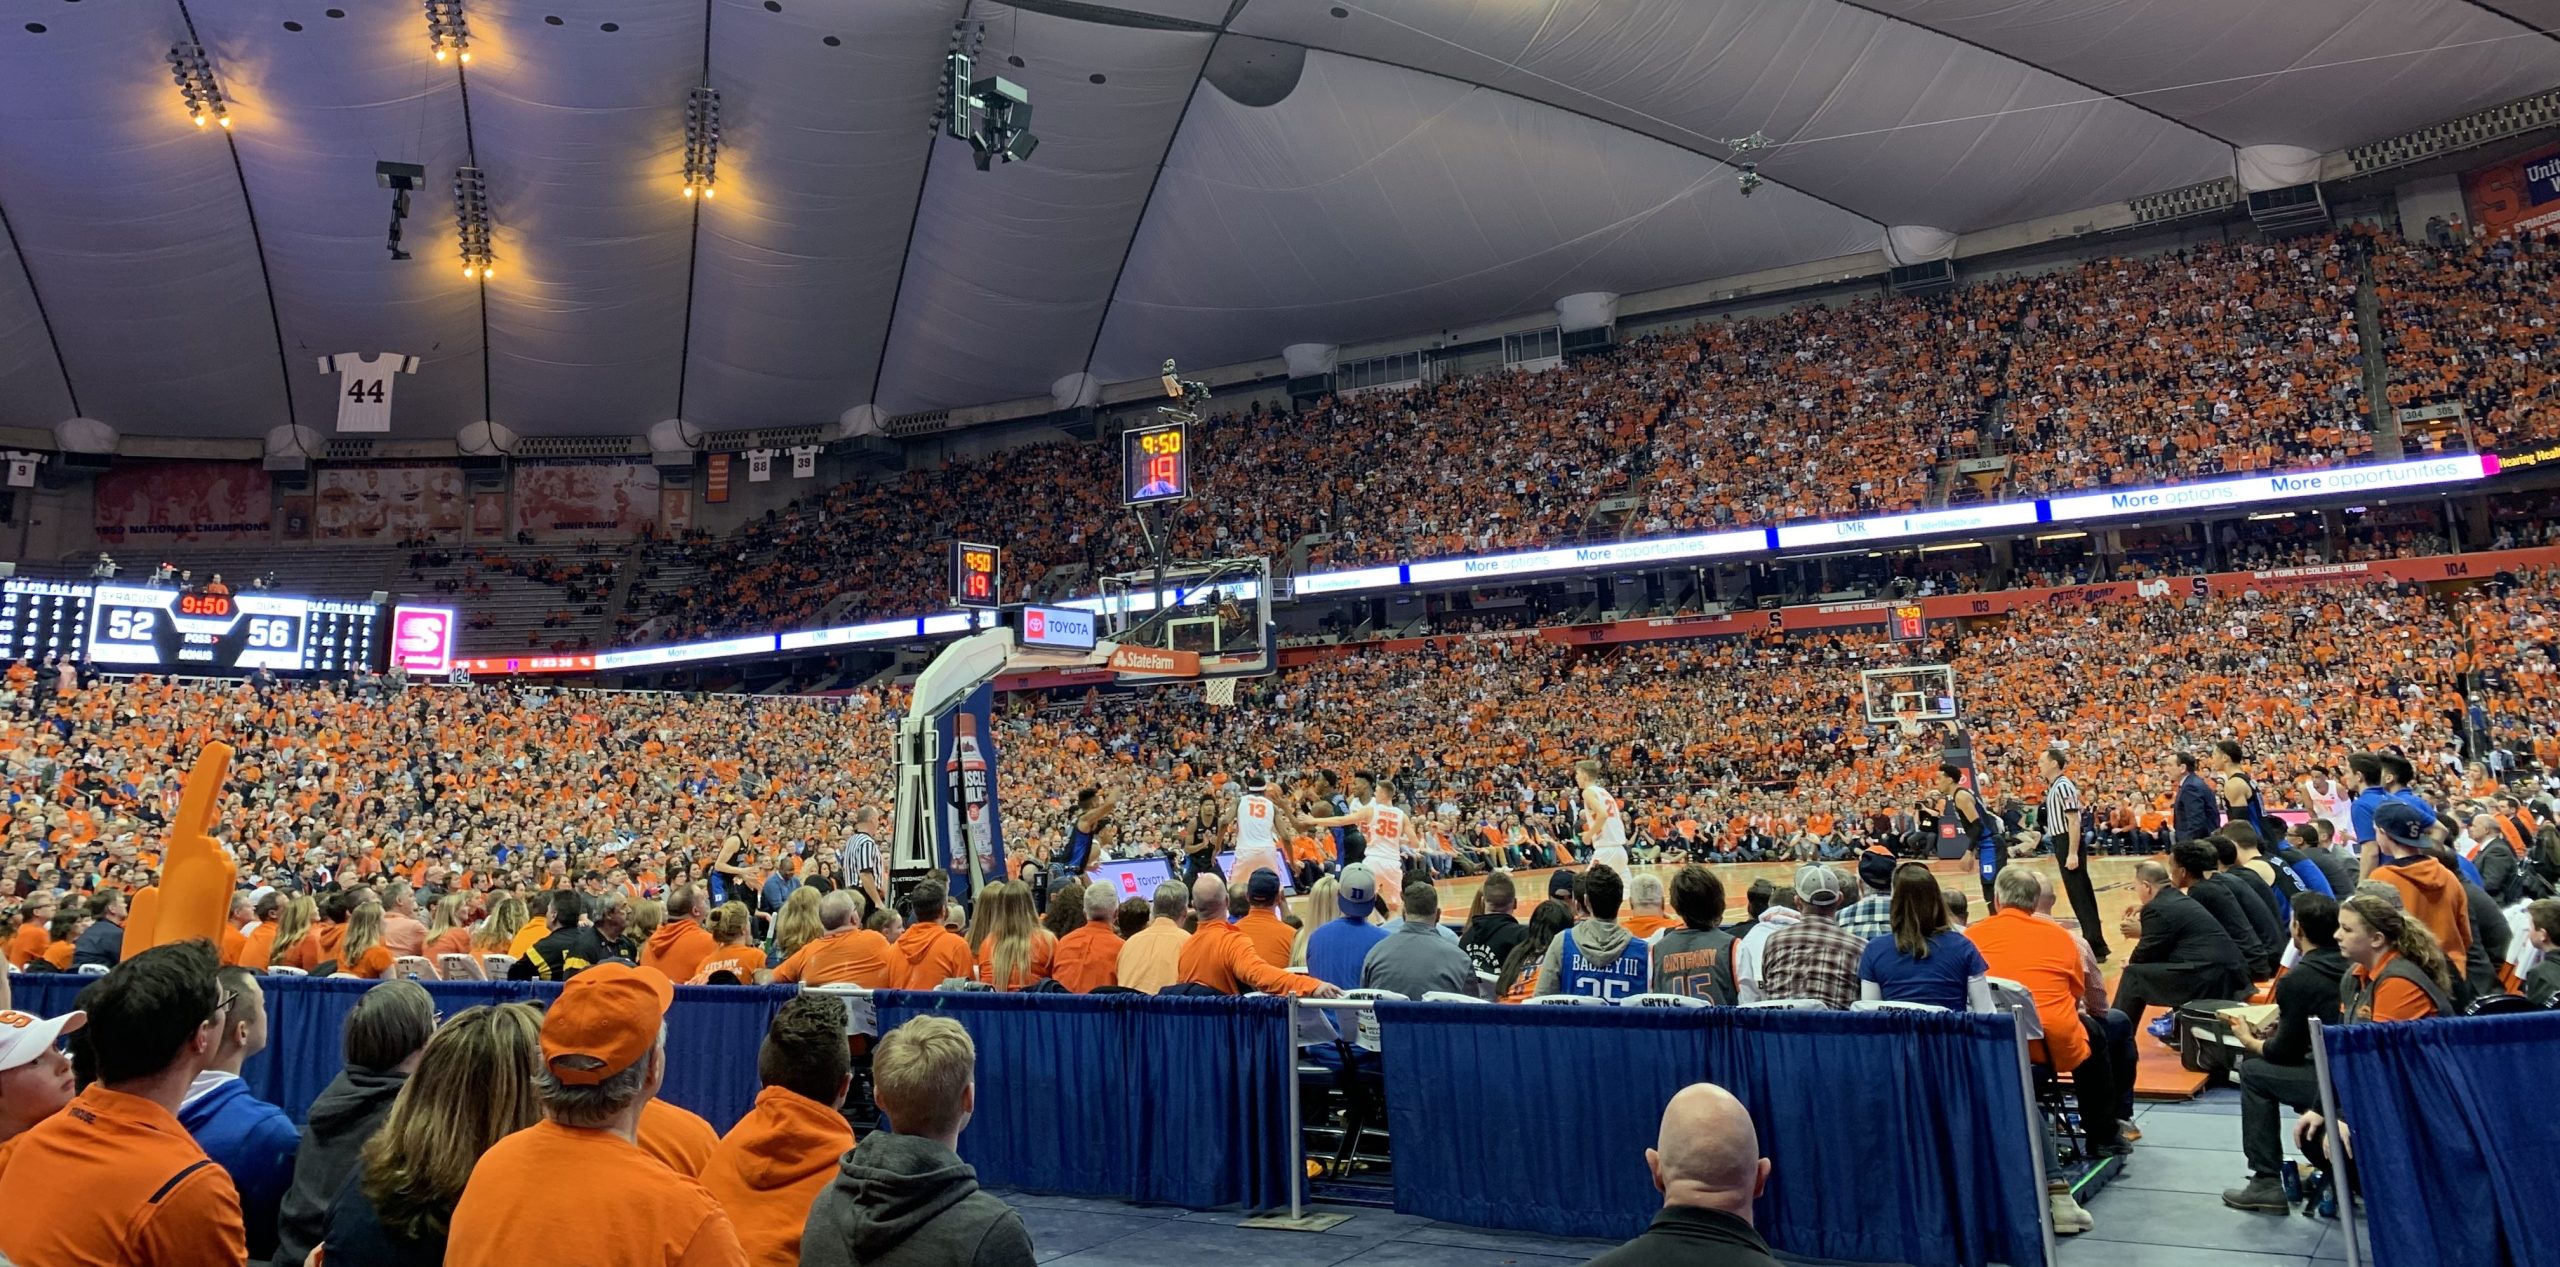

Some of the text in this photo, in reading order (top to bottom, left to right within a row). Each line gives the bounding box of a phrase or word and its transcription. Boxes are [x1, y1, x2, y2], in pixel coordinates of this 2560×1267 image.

[347, 379, 385, 403] 44
[2406, 409, 2423, 420] 304
[1142, 432, 1181, 455] 9:50
[590, 458, 621, 467] Trophy
[753, 461, 767, 472] 88
[798, 457, 811, 468] 39
[1976, 460, 1992, 469] 303
[2498, 454, 2536, 469] Hearing
[18, 465, 26, 476] 9
[2271, 474, 2322, 494] More
[2111, 493, 2159, 510] More
[129, 524, 191, 535] NATIONAL
[195, 522, 270, 533] CHAMPIONS
[553, 521, 618, 530] ERNIE DAVIS
[1837, 521, 1866, 533] UMR
[1576, 548, 1611, 562] More
[966, 553, 991, 572] 9:50
[1465, 560, 1499, 573] More
[2254, 570, 2274, 579] NEW
[2305, 565, 2343, 575] COLLEGE
[2344, 562, 2368, 573] TEAM
[2444, 562, 2468, 577] 104
[970, 574, 986, 597] 19
[2137, 579, 2170, 599] lyft
[101, 592, 160, 604] SYRACUSE
[182, 595, 229, 616] 9:50
[1819, 605, 1834, 614] NEW
[1972, 600, 1990, 613] 103
[75, 611, 84, 621] 4
[349, 615, 354, 623] 1
[1897, 607, 1920, 618] 9:50
[53, 623, 59, 633] 1
[109, 609, 156, 641] 52
[348, 626, 353, 635] 1
[1049, 619, 1089, 636] TOYOTA
[1903, 619, 1920, 637] 19
[184, 633, 212, 644] POSS
[248, 618, 290, 648] 56
[1589, 630, 1604, 641] 102
[178, 649, 213, 661] BONUS
[361, 650, 368, 660] 7
[606, 655, 625, 665] More
[344, 661, 350, 671] 1
[451, 668, 468, 682] 124
[1248, 803, 1266, 819] 13
[1375, 819, 1399, 838] 35
[2409, 824, 2420, 837] S
[1136, 875, 1166, 887] TOYOTA
[1351, 888, 1364, 899] D
[1572, 954, 1638, 977] BAEY III
[1663, 948, 1718, 973] ANTHONY
[1672, 973, 1714, 1006] 15
